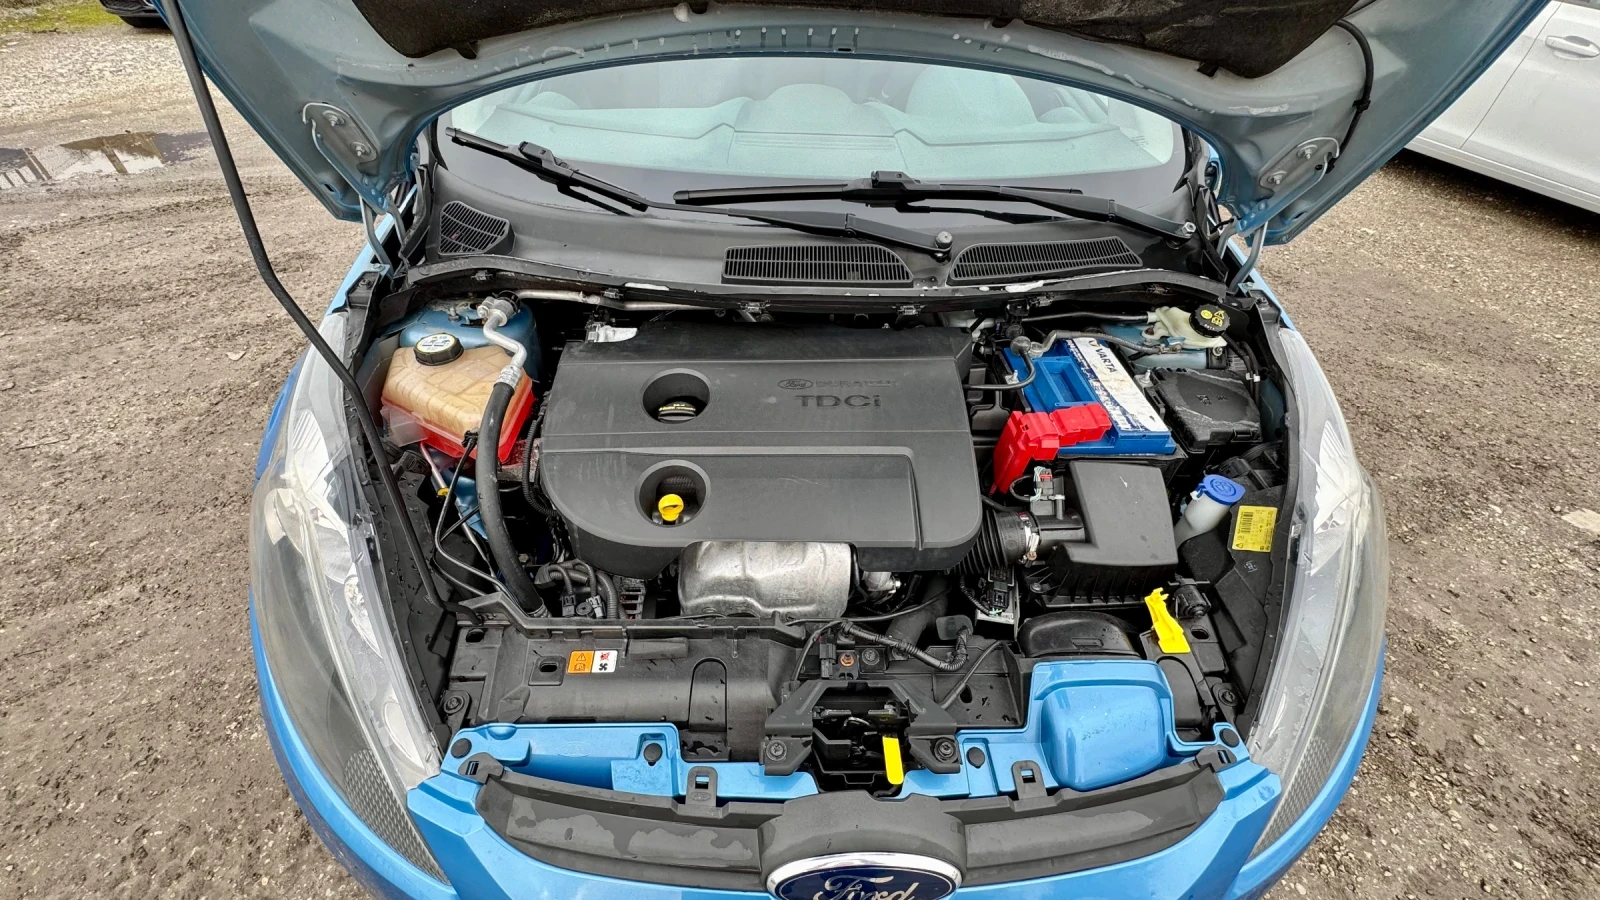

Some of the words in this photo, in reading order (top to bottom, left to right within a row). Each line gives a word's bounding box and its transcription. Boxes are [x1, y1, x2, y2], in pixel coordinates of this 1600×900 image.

[1095, 347, 1118, 373] VARTA
[783, 380, 808, 389] Ford
[795, 394, 882, 407] TDCi
[813, 875, 920, 900] Ford
